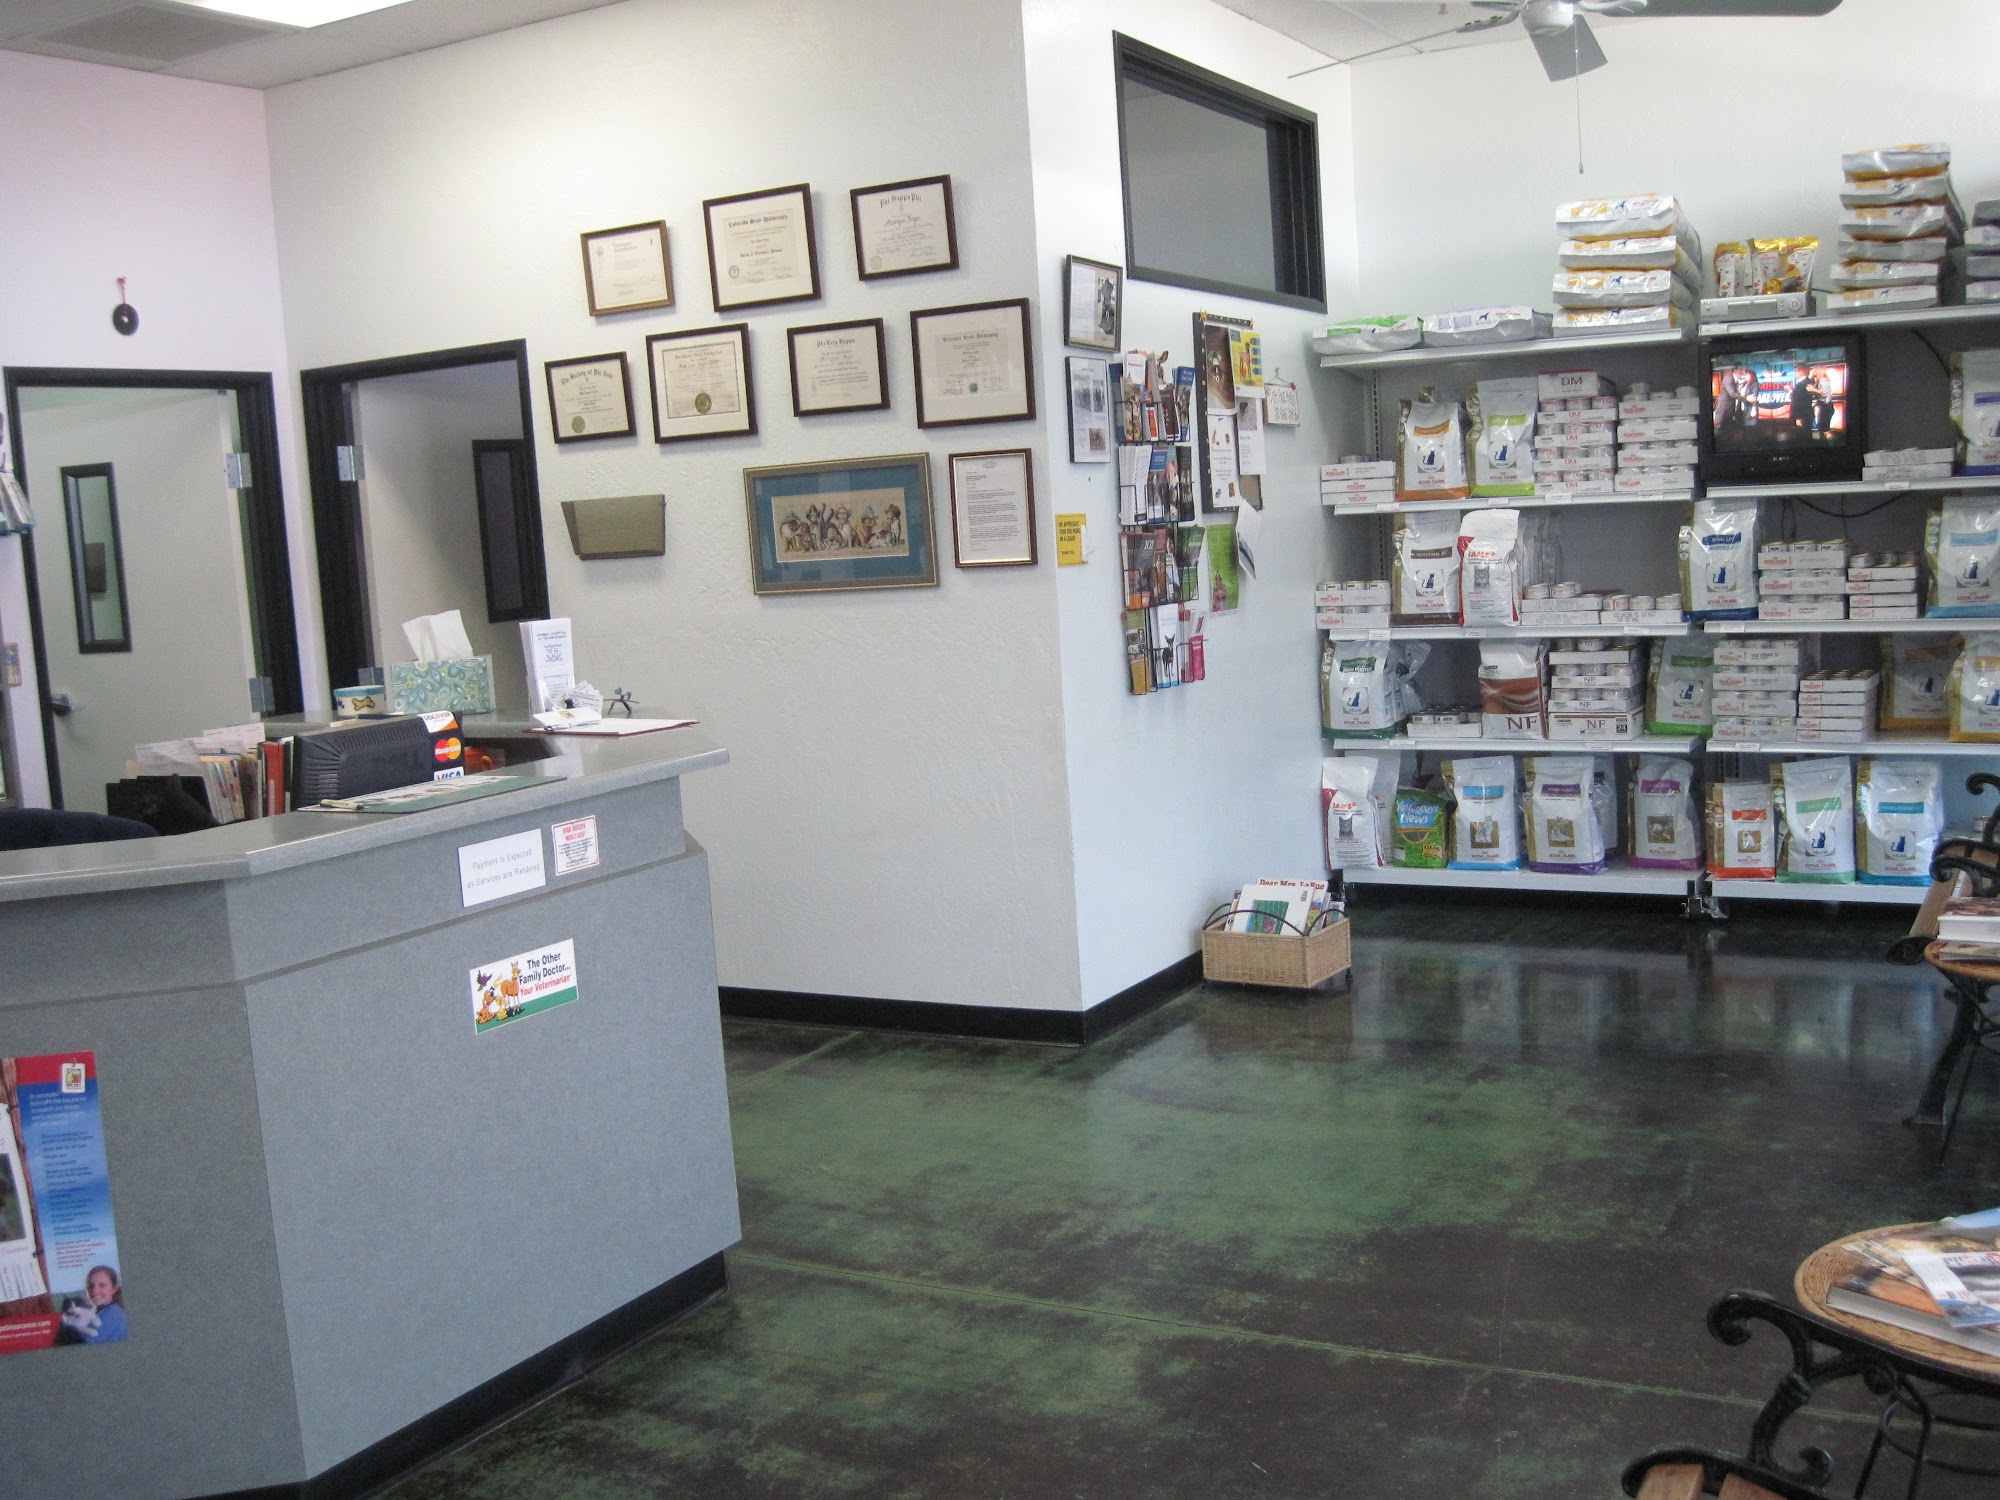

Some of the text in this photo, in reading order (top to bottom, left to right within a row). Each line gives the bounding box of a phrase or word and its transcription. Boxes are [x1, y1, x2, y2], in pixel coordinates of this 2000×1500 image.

[1561, 376, 1583, 386] DM
[1505, 715, 1538, 730] NF
[1587, 719, 1606, 729] NF
[472, 857, 498, 870] Payment
[506, 848, 532, 862] Expected
[467, 864, 540, 889] as Services are Rendered
[527, 952, 561, 970] The Other
[519, 963, 571, 985] Family Doctor...
[520, 974, 571, 997] Your Veterinarian
